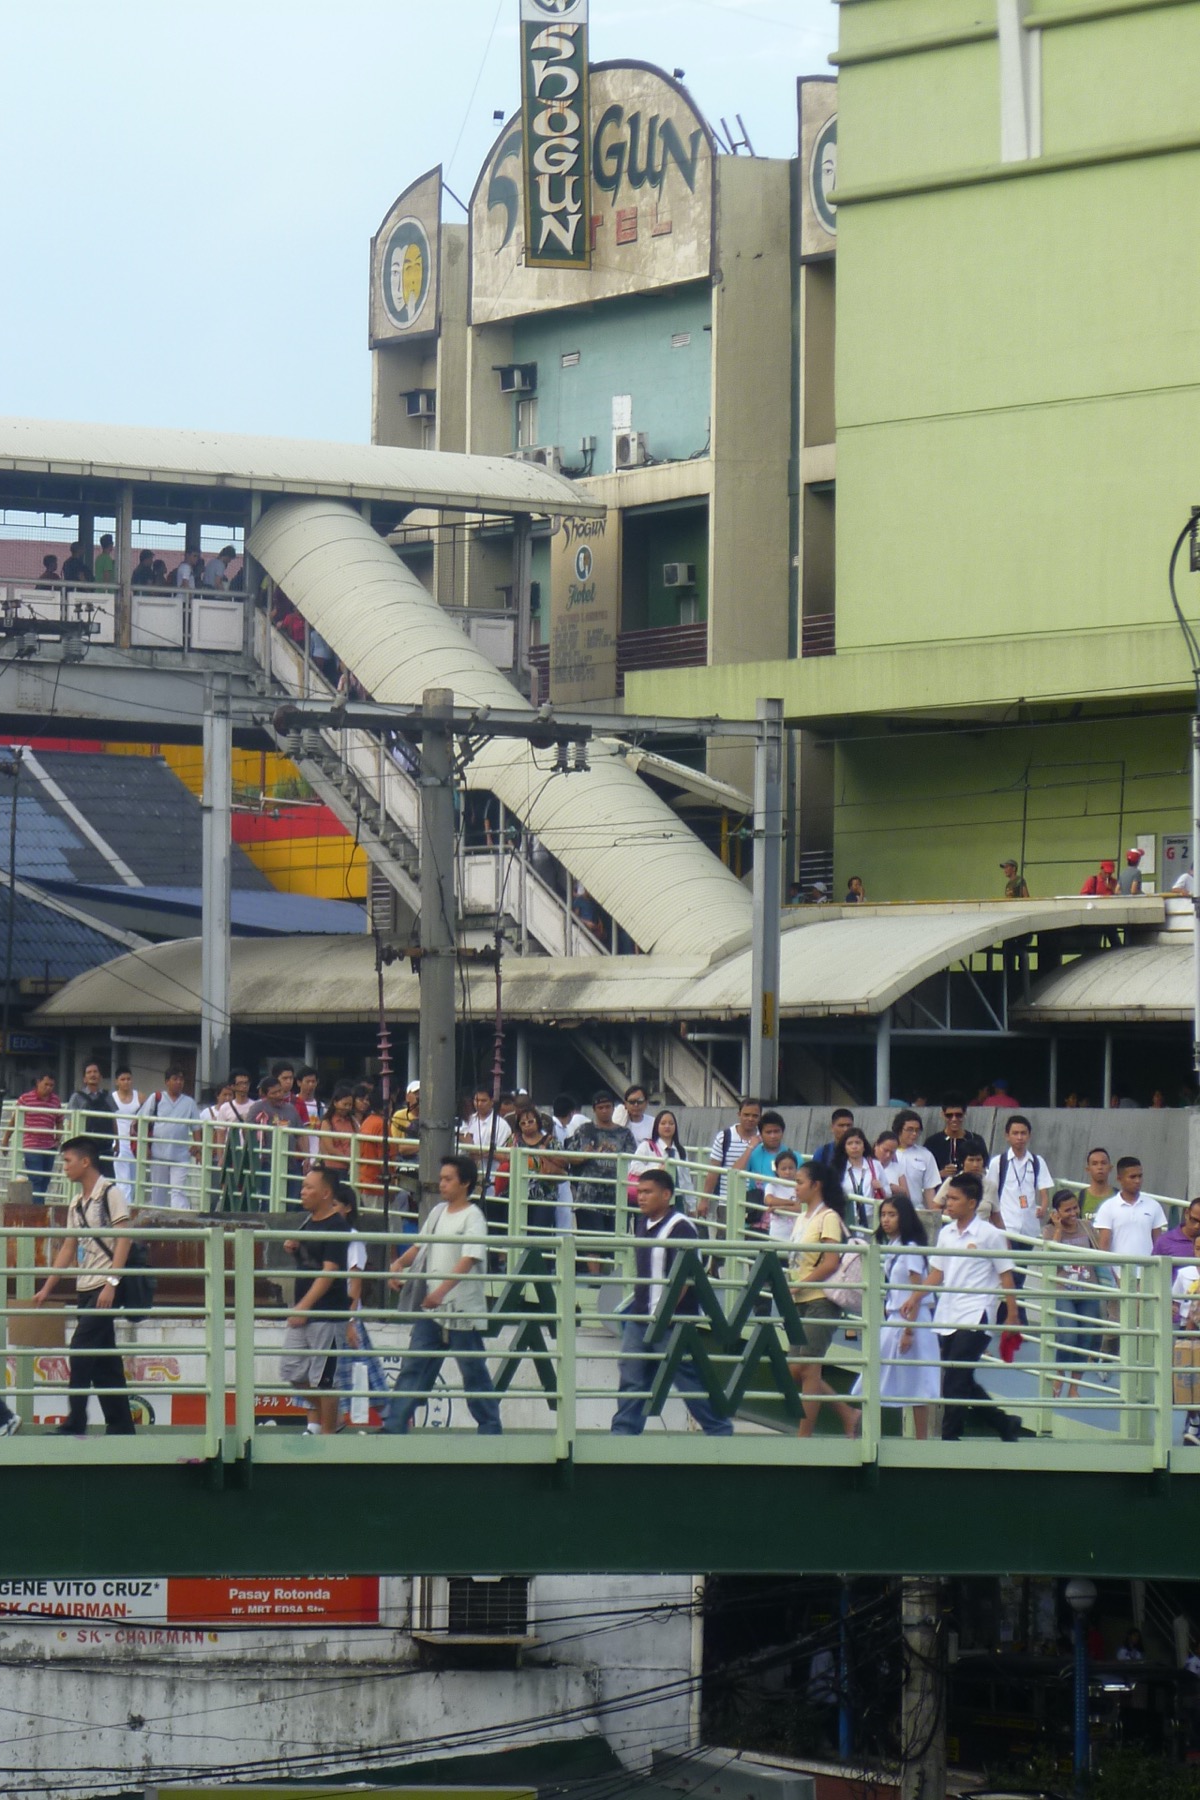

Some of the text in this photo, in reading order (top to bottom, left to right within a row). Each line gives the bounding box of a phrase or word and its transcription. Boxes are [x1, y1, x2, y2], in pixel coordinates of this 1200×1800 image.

[530, 23, 583, 256] SHOGUN
[487, 104, 703, 256] SGUN
[566, 582, 596, 611] Hotel
[54, 1582, 96, 1596] VITO
[229, 1588, 330, 1602] Pasay Rotonda
[248, 1605, 271, 1614] MRT
[274, 1605, 304, 1614] EDSA
